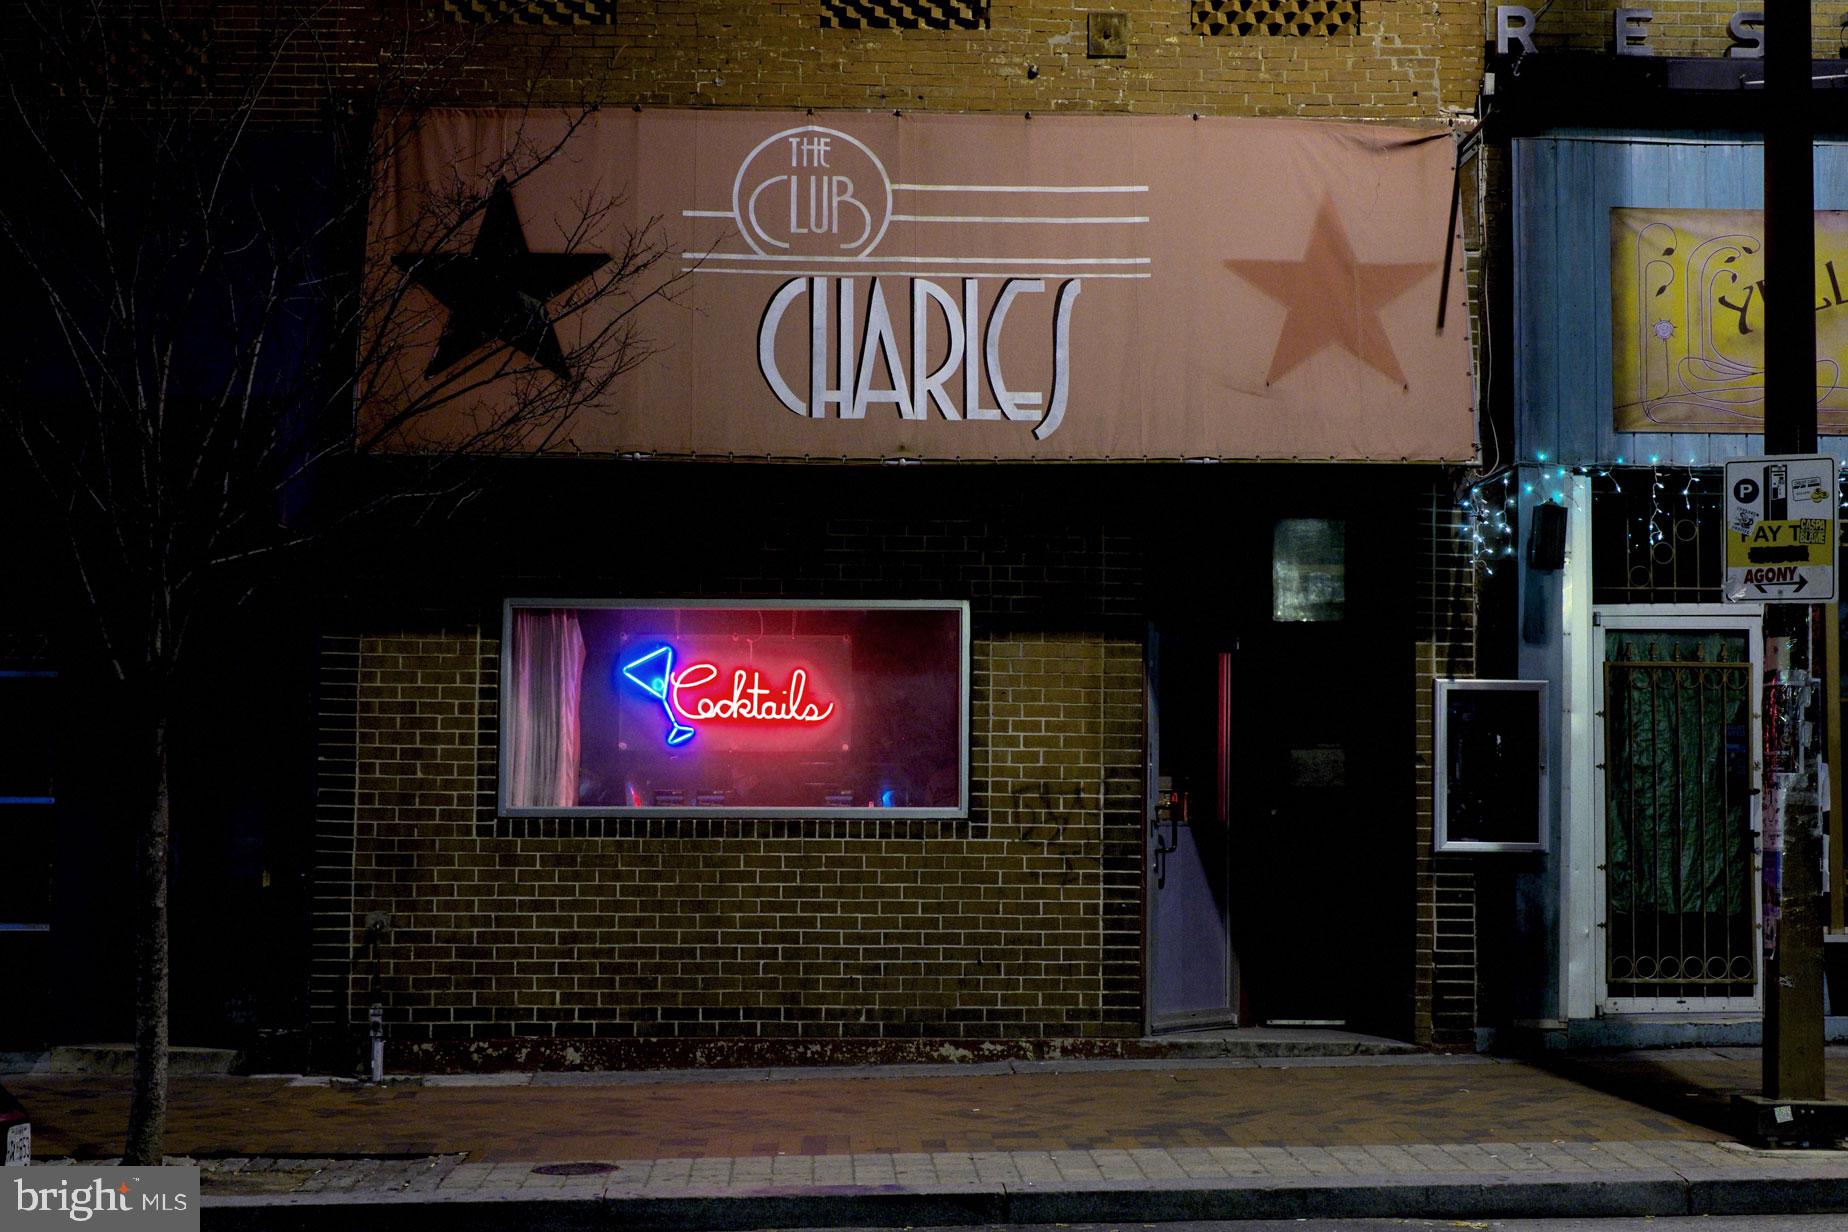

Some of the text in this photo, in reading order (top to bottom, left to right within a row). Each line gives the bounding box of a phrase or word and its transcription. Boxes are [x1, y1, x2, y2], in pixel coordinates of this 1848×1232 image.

[788, 137, 831, 168] THE
[749, 175, 872, 249] CLUB
[757, 276, 1082, 441] CHARLES
[1744, 566, 1798, 584] AGONY
[670, 663, 834, 722] Cocktails
